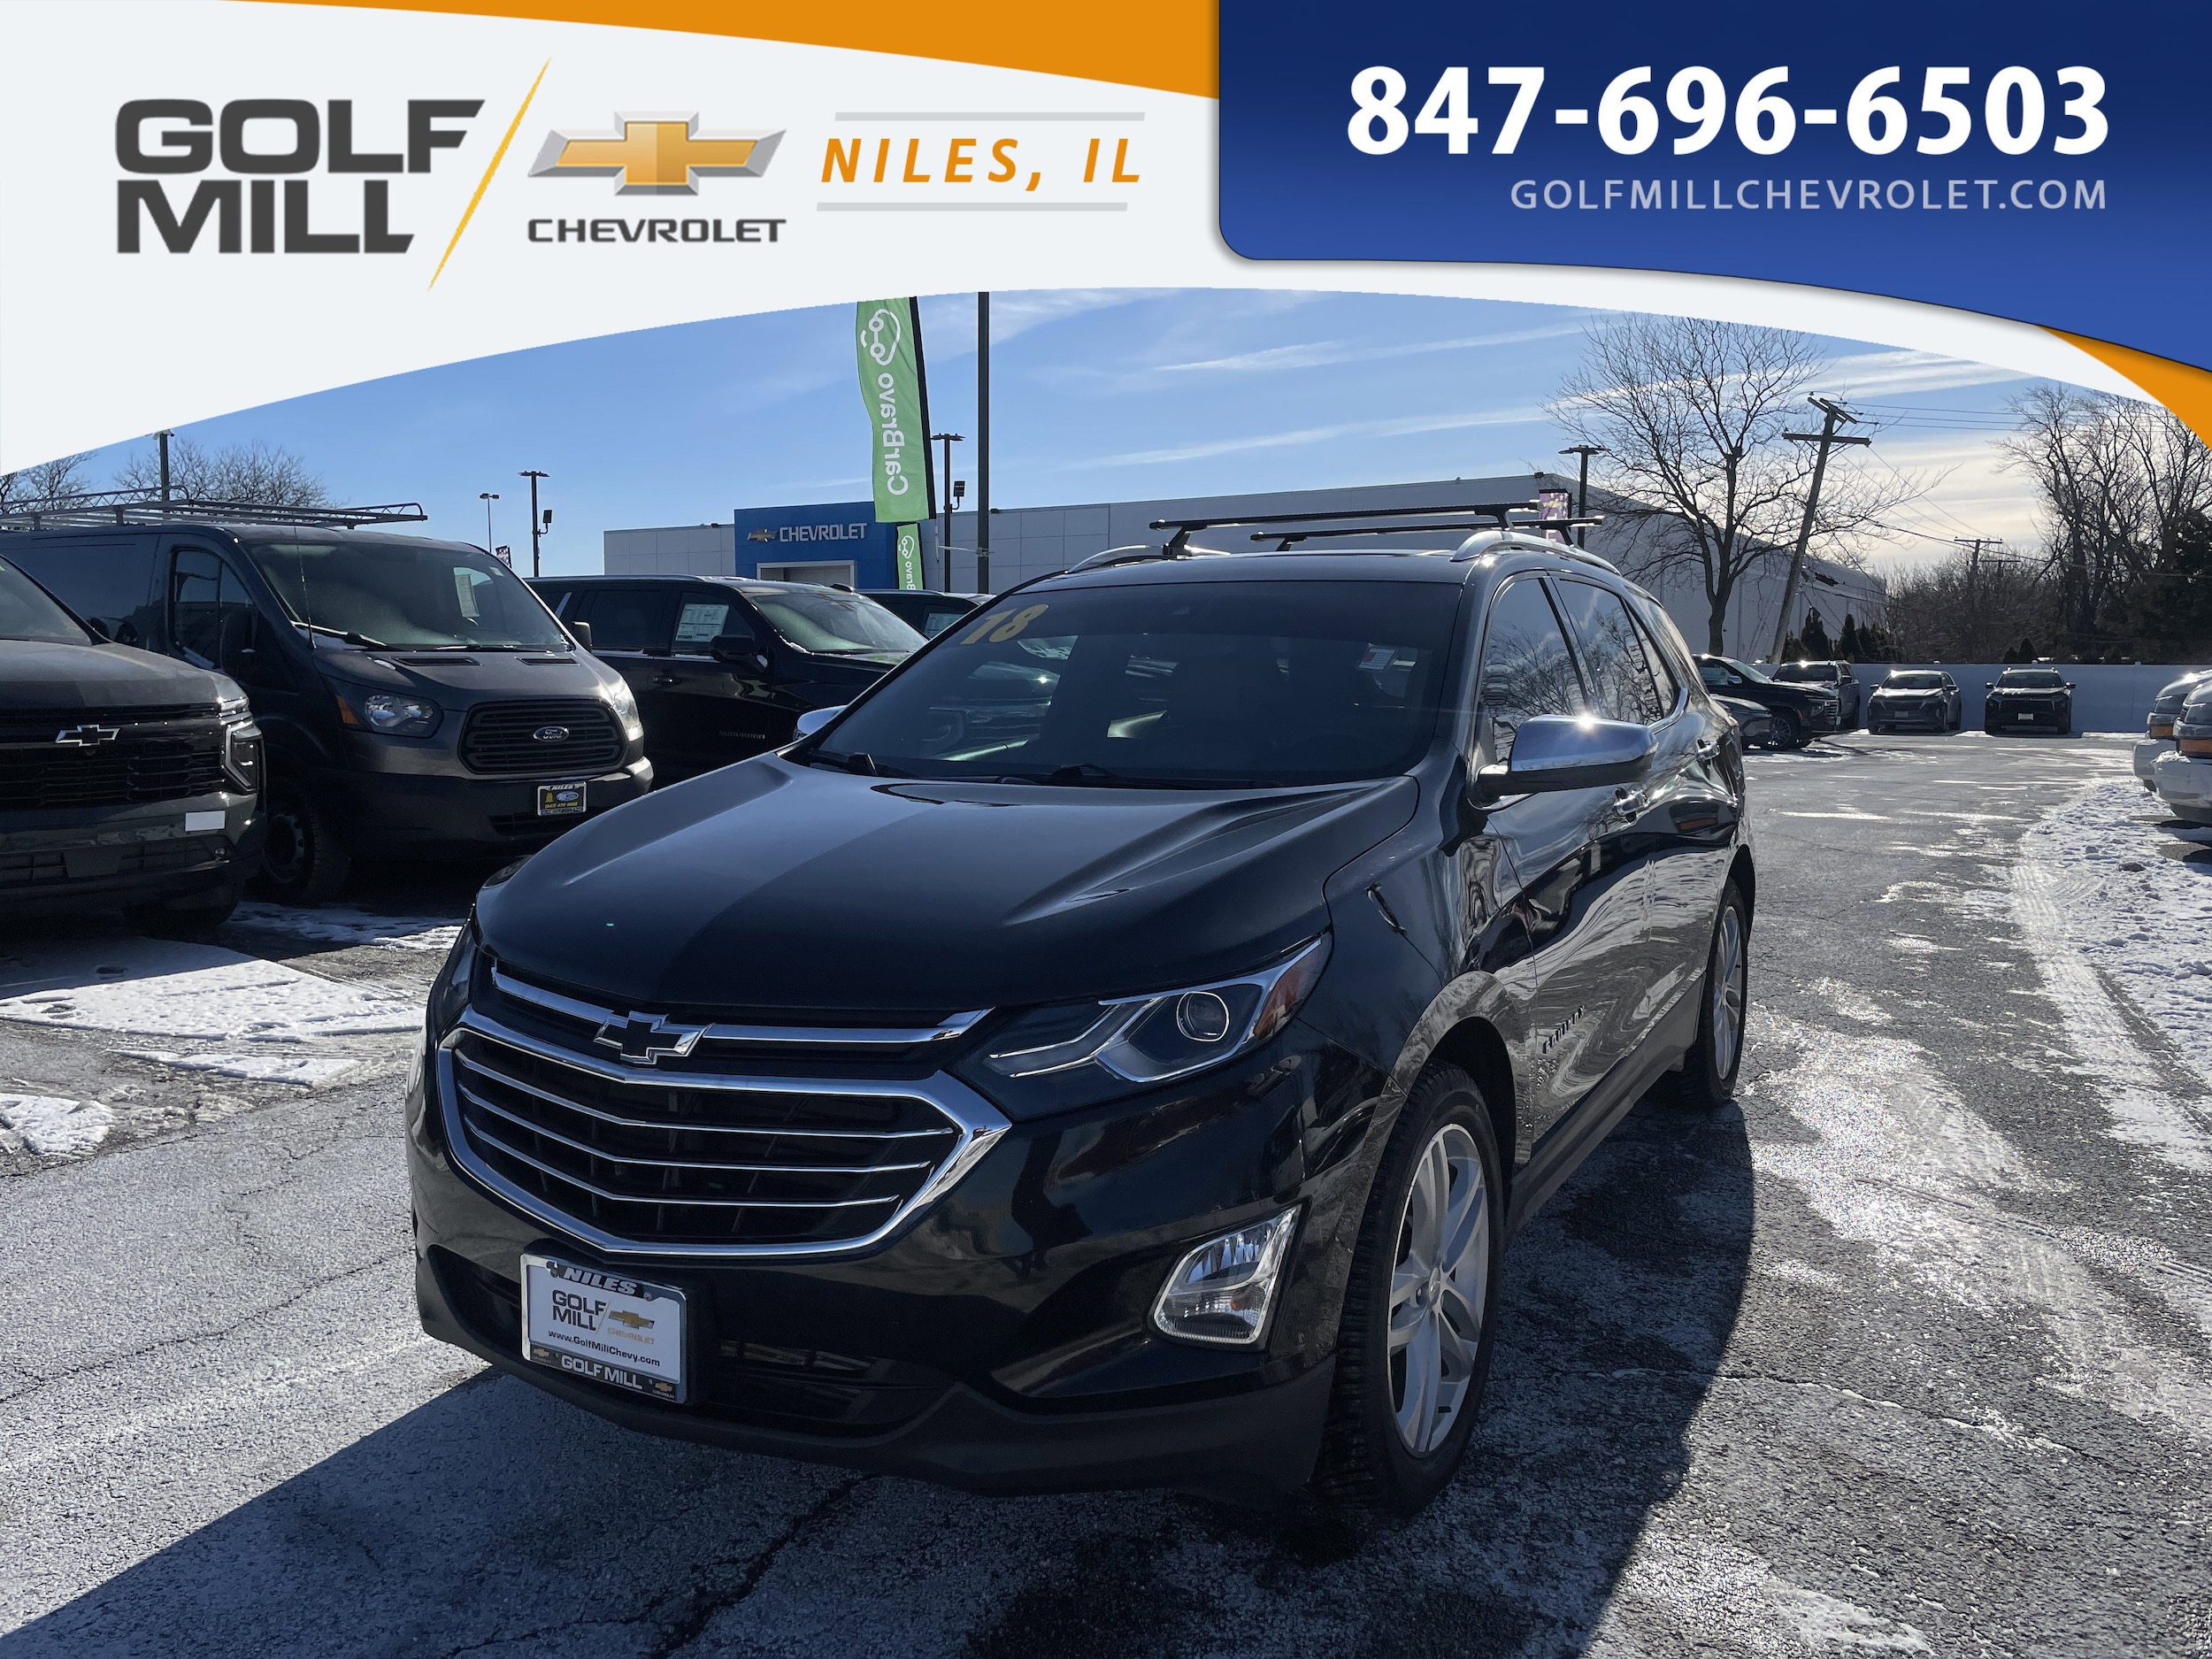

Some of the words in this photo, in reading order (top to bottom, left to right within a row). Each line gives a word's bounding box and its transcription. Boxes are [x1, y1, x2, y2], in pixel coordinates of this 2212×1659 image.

[779, 522, 868, 542] CHEVROLET
[959, 603, 1049, 645] 18
[564, 1267, 637, 1294] NILES
[552, 1289, 606, 1316] GOLF
[552, 1305, 596, 1332] MILL
[548, 1330, 660, 1367] www.GolfMillChevy.com
[607, 1327, 656, 1345] CHEVROLET
[561, 1355, 603, 1377] GOLF
[604, 1367, 643, 1390] MILL
